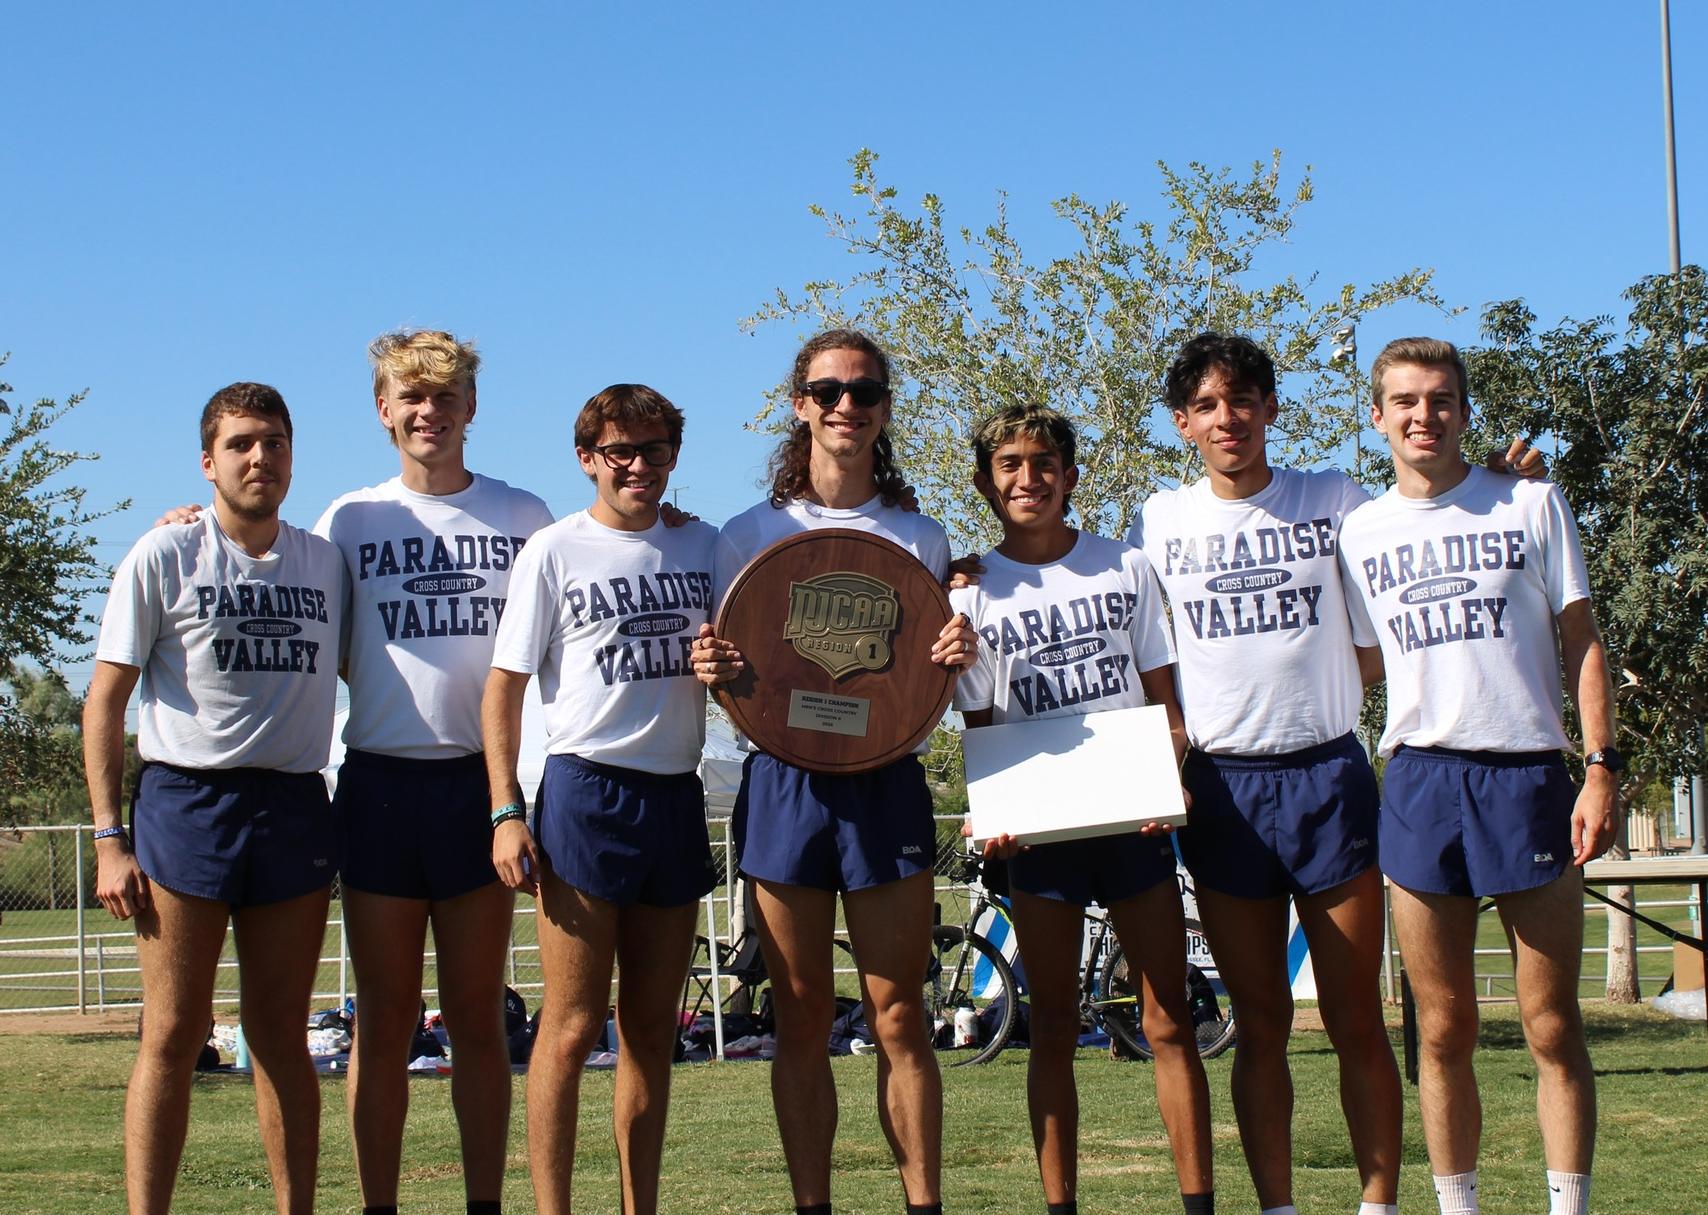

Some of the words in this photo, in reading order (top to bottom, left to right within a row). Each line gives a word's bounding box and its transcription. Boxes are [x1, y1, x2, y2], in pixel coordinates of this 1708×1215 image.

[1165, 517, 1335, 576] PARADISE
[1362, 530, 1525, 598] PARADISE
[414, 580, 438, 592] CROSS
[441, 578, 478, 590] COUNTRY
[565, 571, 712, 628] PARADISE
[1216, 577, 1241, 591] CROSS
[1244, 572, 1283, 587] COUNTRY
[1407, 588, 1429, 602] CROSS
[1430, 580, 1468, 595] COUNTRY
[197, 585, 328, 623] PARADISE
[1183, 585, 1322, 639] VALLEY
[246, 623, 265, 633] CROSS
[266, 624, 295, 634] COUNTRY
[628, 621, 651, 634] CROSS
[653, 618, 685, 631] COUNTRY
[979, 592, 1137, 661] PARADISE
[1387, 597, 1507, 655] VALLEY
[212, 639, 319, 674] VALLEY
[593, 636, 700, 685] VALLE
[807, 638, 853, 654] REGION
[868, 643, 876, 659] 1
[1039, 651, 1063, 664] CROSS
[1064, 640, 1101, 660] COUNTRY
[1010, 653, 1130, 716] VALLEY
